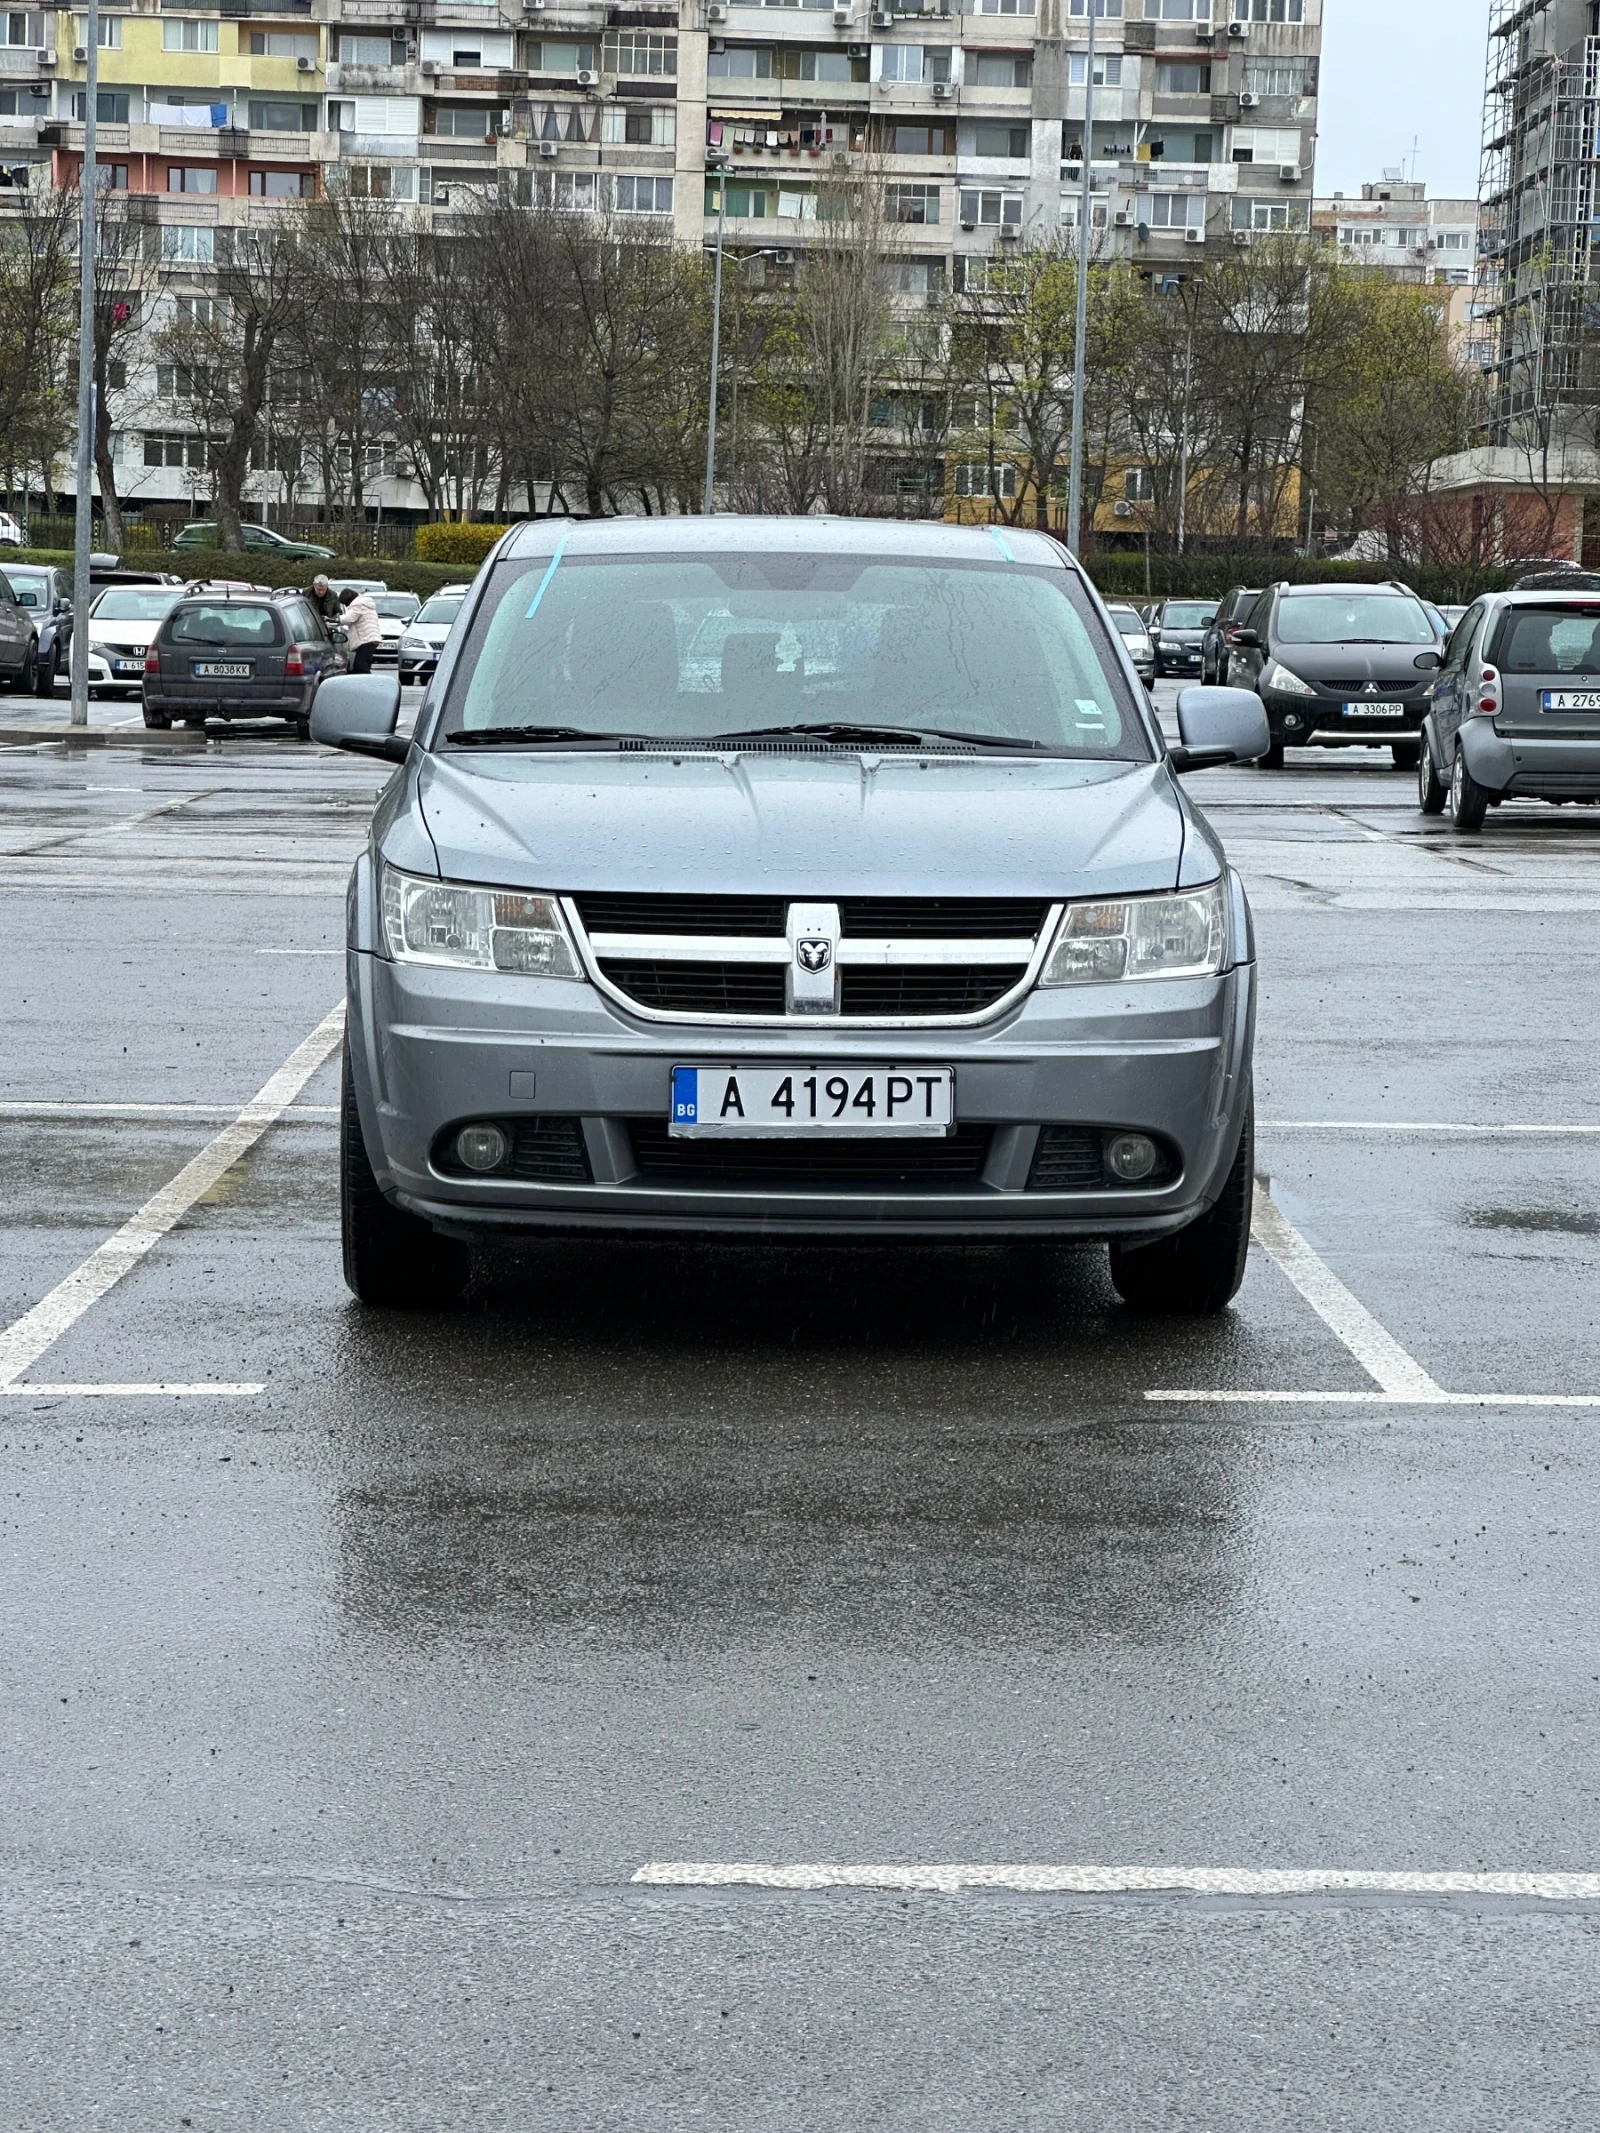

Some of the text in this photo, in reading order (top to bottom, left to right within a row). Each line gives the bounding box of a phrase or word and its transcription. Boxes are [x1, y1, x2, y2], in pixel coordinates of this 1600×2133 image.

[204, 664, 210, 674] A
[213, 664, 248, 675] 8038KK
[1557, 694, 1566, 707] A
[1353, 704, 1359, 714] A
[1364, 704, 1402, 715] 3306PP
[720, 1076, 942, 1118] A 4194PT
[677, 1103, 696, 1116] BG
